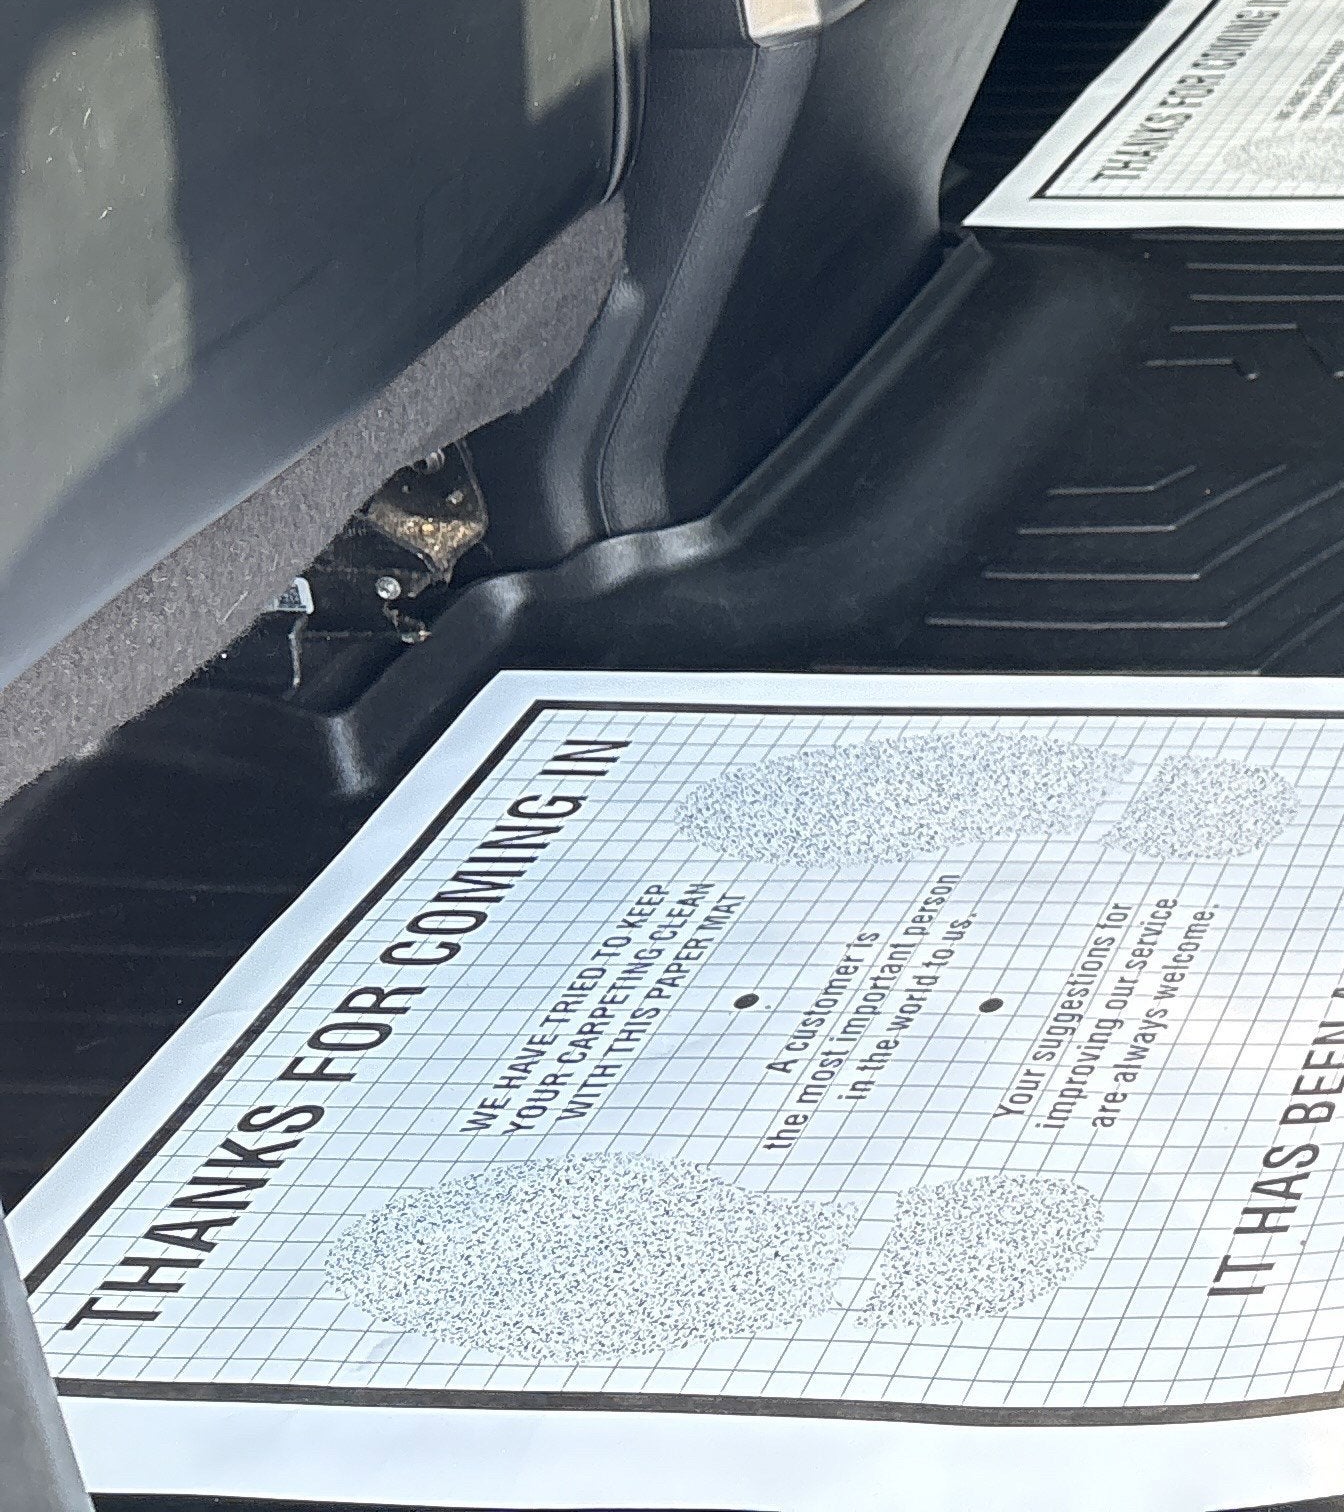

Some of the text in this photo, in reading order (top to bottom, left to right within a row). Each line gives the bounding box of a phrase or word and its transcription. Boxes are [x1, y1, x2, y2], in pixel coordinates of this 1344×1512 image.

[1090, 112, 1193, 183] THANKS
[1156, 73, 1226, 108] FOR
[63, 738, 632, 1331] THANKS FOR COMING IN
[460, 884, 669, 1132] WE HAVE TRIED TO KEEP
[502, 883, 716, 1135] YOUR CARPETING CLEAN
[555, 892, 746, 1121] WITH THIS PAPER MAT
[763, 874, 961, 1150] the most important person
[766, 932, 880, 1074] A customer is
[837, 912, 978, 1100] in the world to us.
[992, 902, 1132, 1119] Your suggestions for
[1035, 898, 1178, 1129] improving our service
[1091, 904, 1220, 1128] are always welcome.
[1207, 1255, 1275, 1297] IT
[1232, 1142, 1320, 1236] HAS
